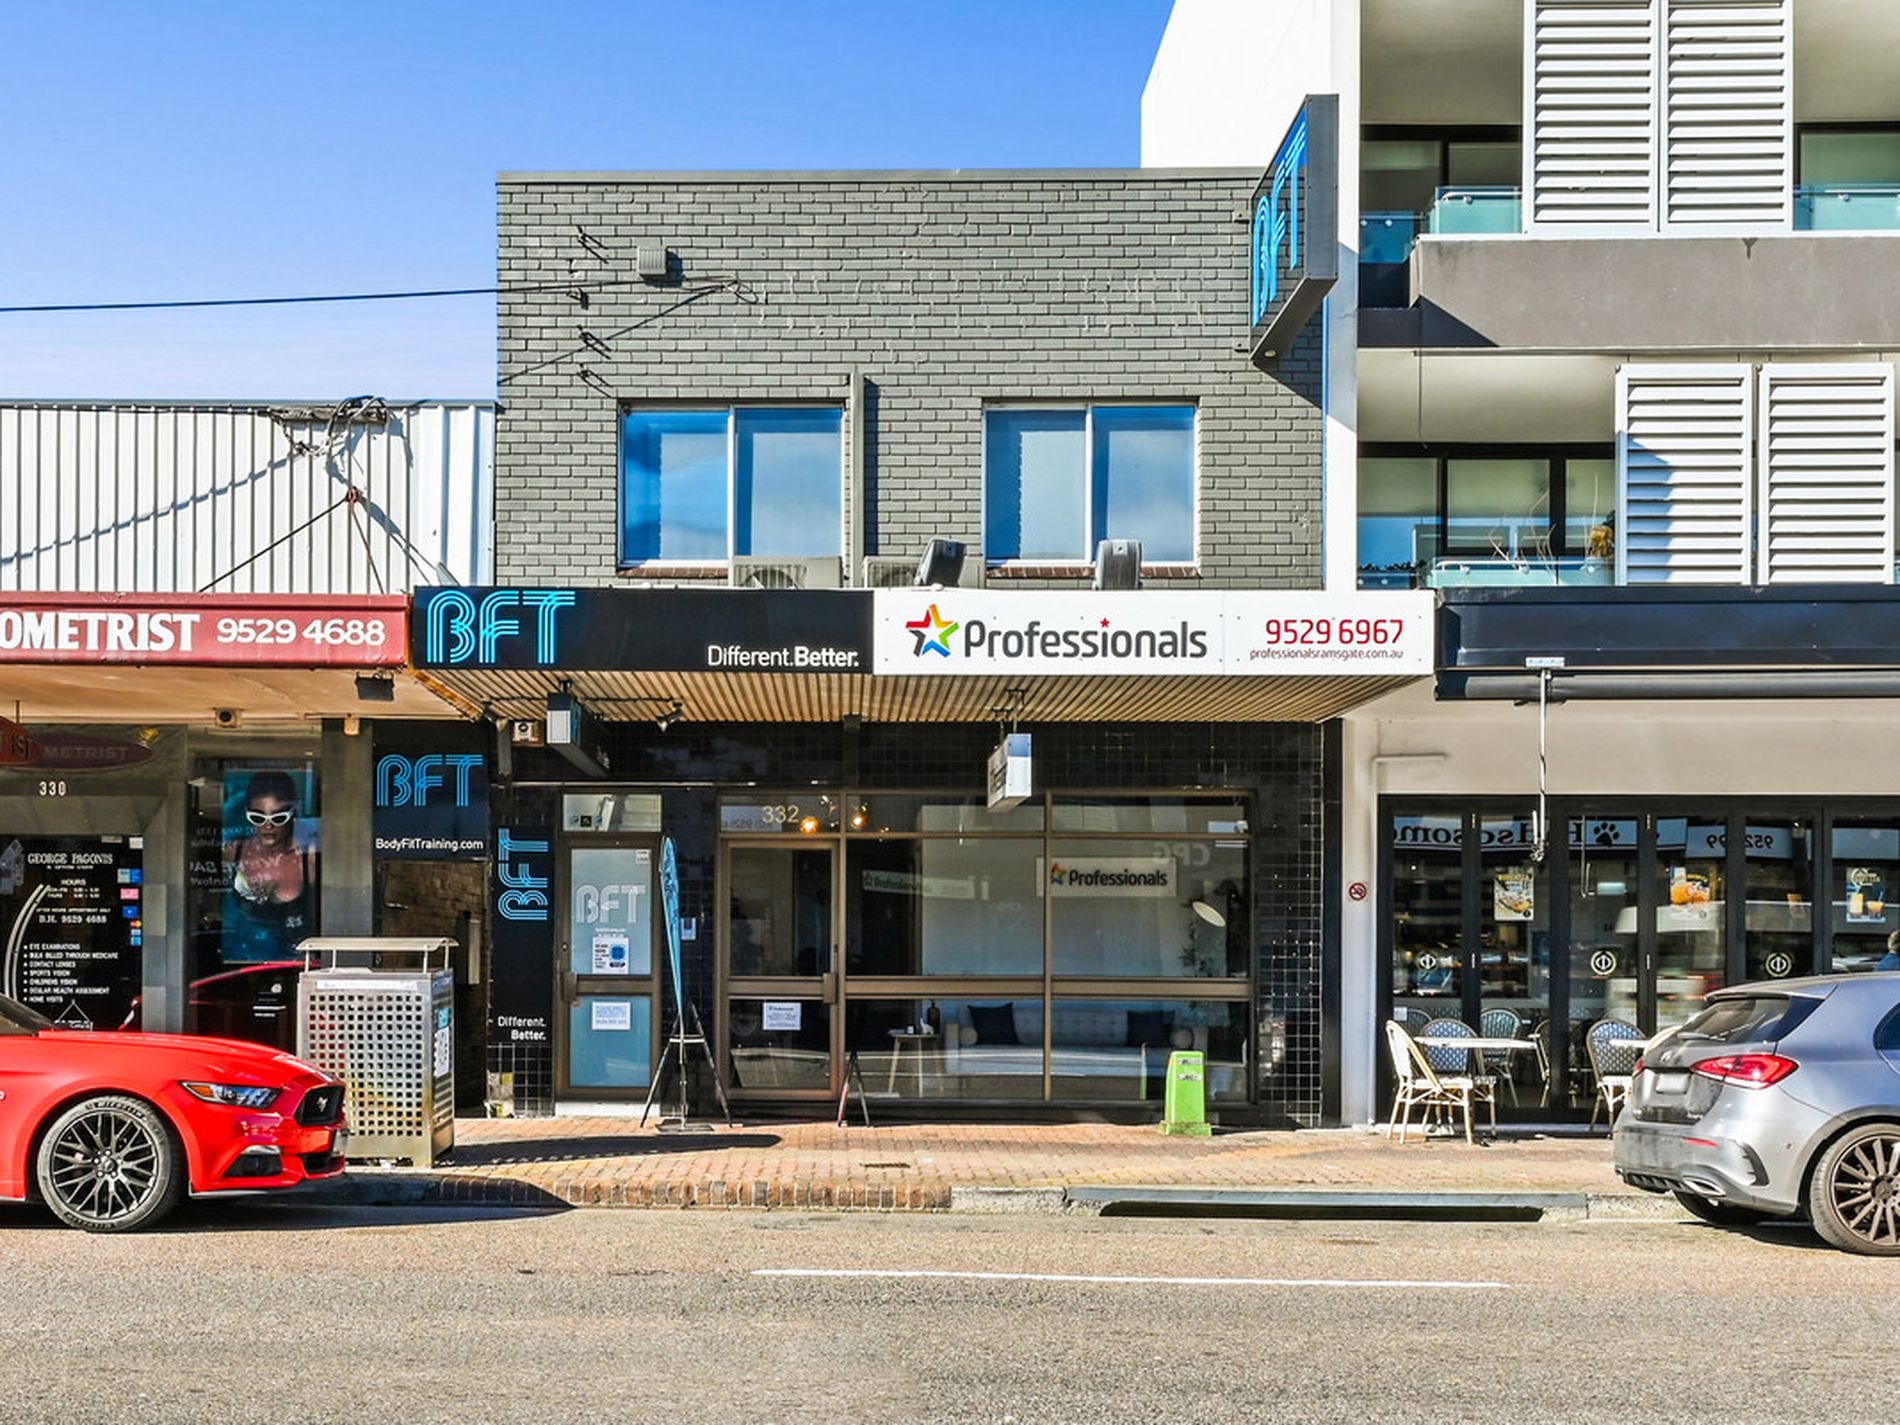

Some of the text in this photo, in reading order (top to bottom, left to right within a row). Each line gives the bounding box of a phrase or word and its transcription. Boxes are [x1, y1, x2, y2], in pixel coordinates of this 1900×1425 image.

[0, 611, 385, 653] OMETRIST 9529 4688
[427, 590, 576, 664] BFT
[1265, 619, 1404, 645] 9529 6967
[964, 617, 1208, 660] Professionals
[1250, 648, 1404, 662] professionalsramsgate.com.au
[39, 780, 67, 796] 330
[376, 754, 484, 807] BFT
[761, 804, 799, 823] 332
[375, 837, 484, 852] BodyFitTraining.com
[27, 853, 68, 865] GEORGE
[497, 827, 549, 921] BFT
[1069, 868, 1168, 888] Professionals
[575, 884, 647, 924] BFT
[497, 1015, 547, 1028] Different.
[510, 1029, 547, 1041] Better.
